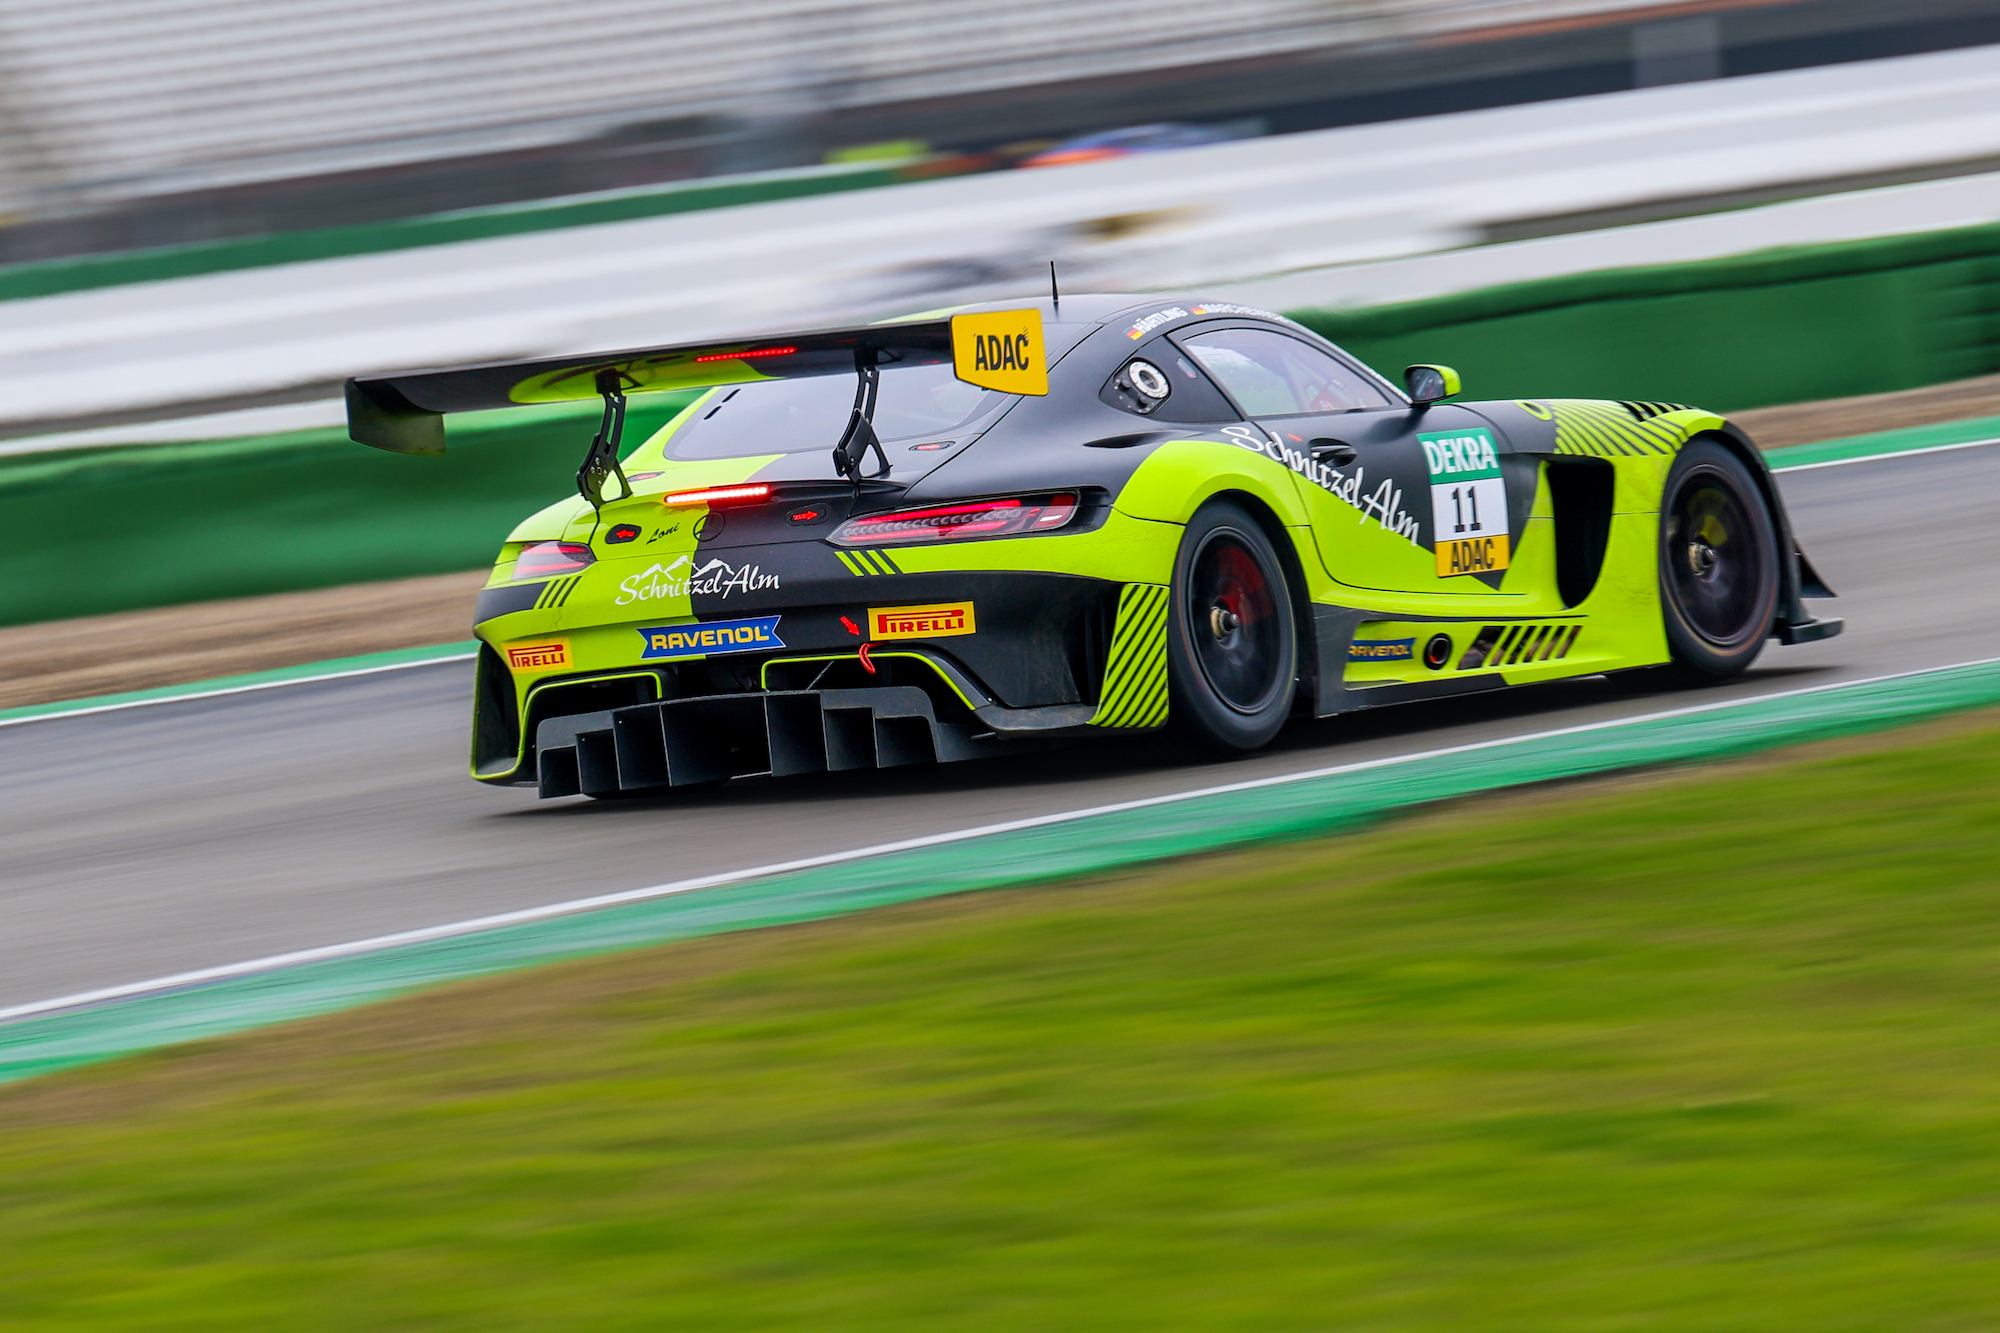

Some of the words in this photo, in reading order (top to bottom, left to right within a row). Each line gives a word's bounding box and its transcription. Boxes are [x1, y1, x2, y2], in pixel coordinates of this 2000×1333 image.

[975, 333, 1029, 371] ADAC
[1422, 434, 1499, 476] DEKRA
[1450, 485, 1482, 534] 11
[1451, 538, 1495, 574] ADAC
[877, 608, 965, 634] PIRELLI
[508, 644, 565, 668] PIRELLI
[1348, 644, 1411, 657] RAVENOL
